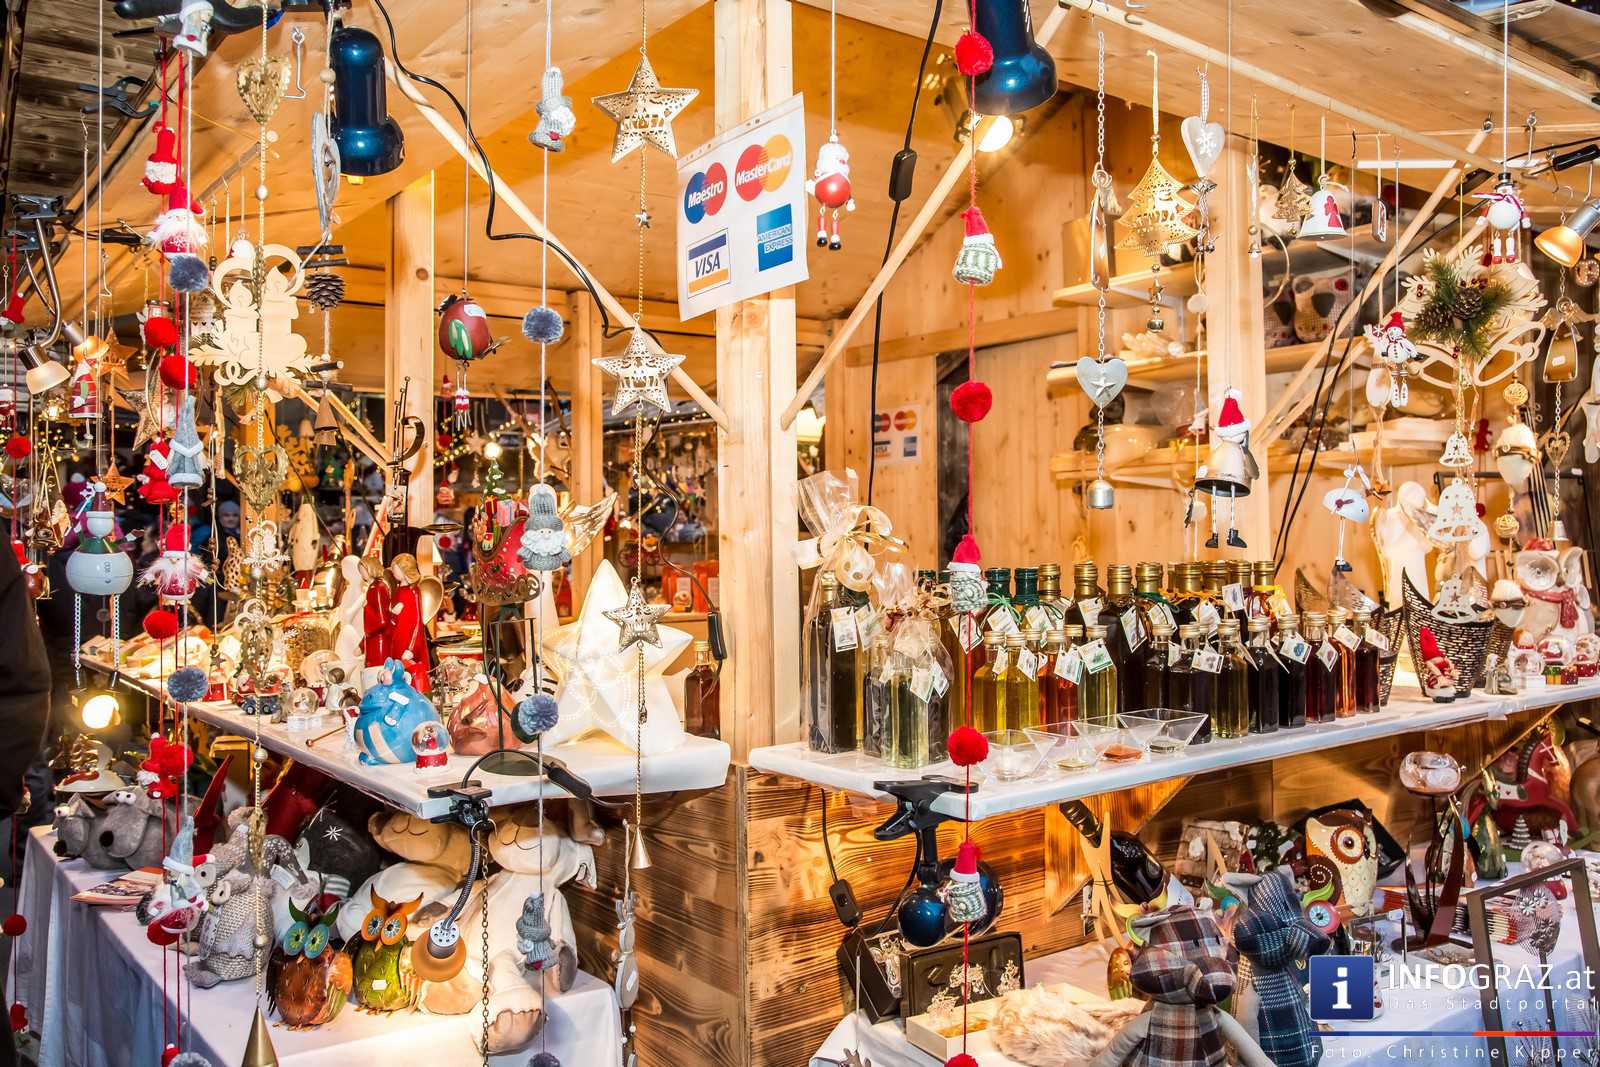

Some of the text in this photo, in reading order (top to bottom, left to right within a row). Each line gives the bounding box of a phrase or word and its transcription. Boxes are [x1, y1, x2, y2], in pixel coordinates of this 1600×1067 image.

[735, 153, 791, 187] MasterCard
[687, 180, 725, 209] Maestro
[757, 224, 792, 243] AMERICAN
[764, 236, 793, 254] EXPRESS
[694, 251, 721, 279] VISA
